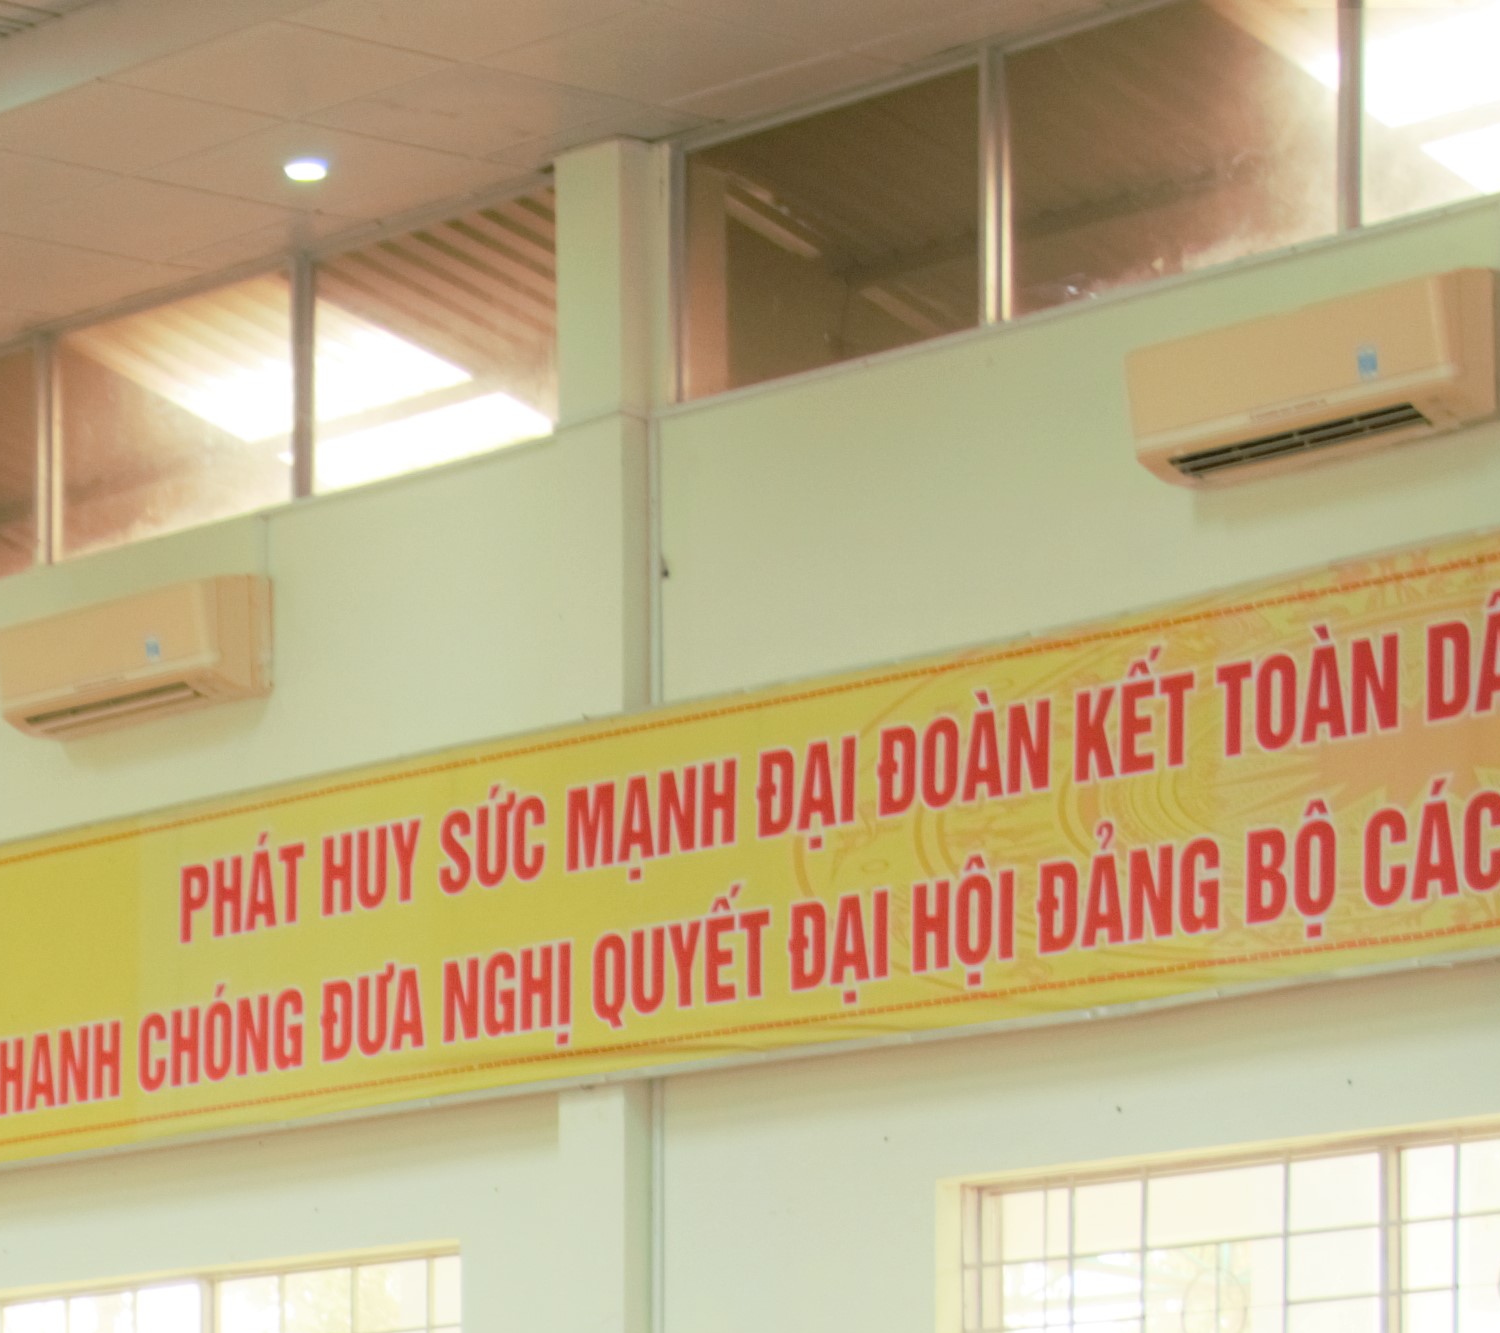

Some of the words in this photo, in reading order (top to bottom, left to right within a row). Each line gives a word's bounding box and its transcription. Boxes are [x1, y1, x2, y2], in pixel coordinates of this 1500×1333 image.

[179, 833, 305, 944] PHÁT
[321, 818, 422, 916] HUY
[437, 783, 547, 897] SỨC
[564, 758, 738, 880] MẠNH
[756, 734, 857, 850] ĐẠI
[876, 690, 1052, 816] ĐOÀN
[1073, 645, 1194, 784] KẾT
[1216, 625, 1399, 756] TOÀN
[138, 984, 305, 1092] CHÓNG
[319, 962, 424, 1058] ĐƯA
[441, 939, 573, 1047] NGHỊ
[591, 884, 771, 1028] QUYẾT
[789, 890, 890, 1006] ĐẠI
[911, 854, 1013, 987] HỘI
[1037, 818, 1221, 955] ĐẢNG
[1244, 800, 1338, 941] BỘ
